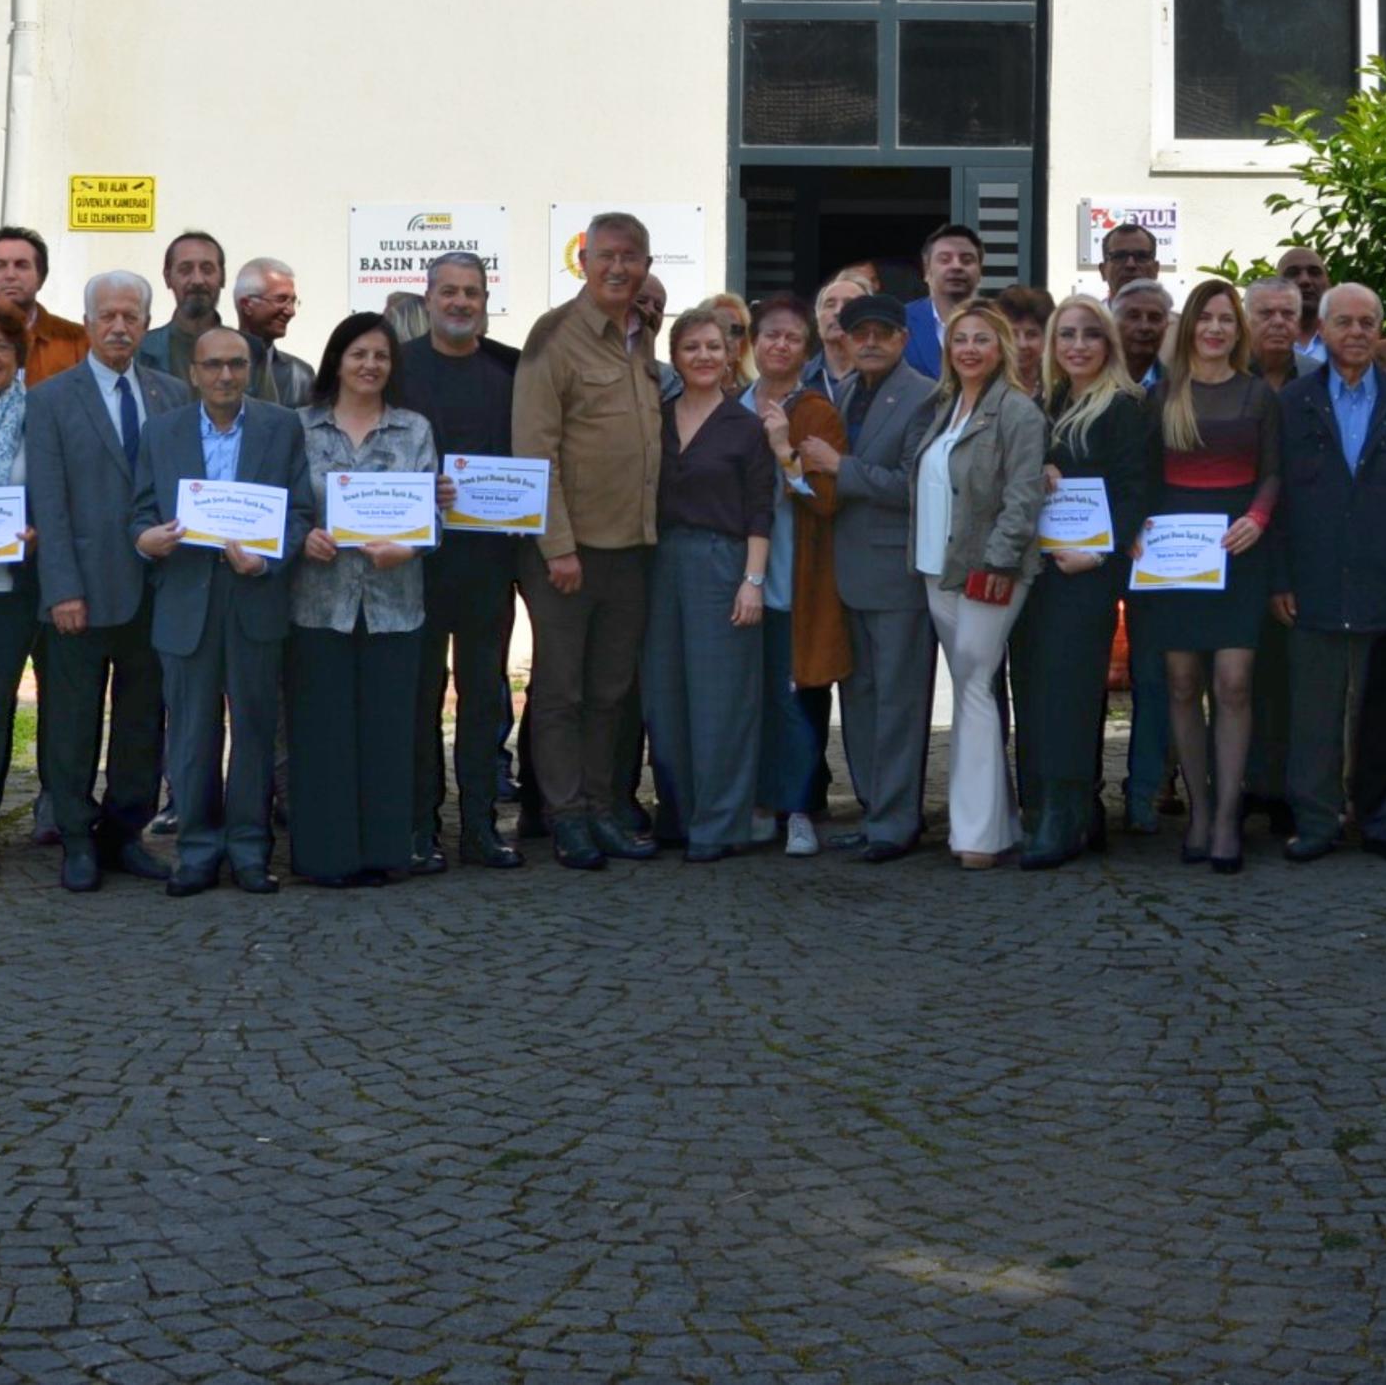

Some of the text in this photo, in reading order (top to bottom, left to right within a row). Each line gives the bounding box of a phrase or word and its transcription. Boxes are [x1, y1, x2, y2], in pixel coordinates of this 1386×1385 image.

[379, 240, 478, 250] ULUSLARARASI
[360, 258, 413, 270] BASIN
[358, 276, 428, 284] INTERNATIONA
